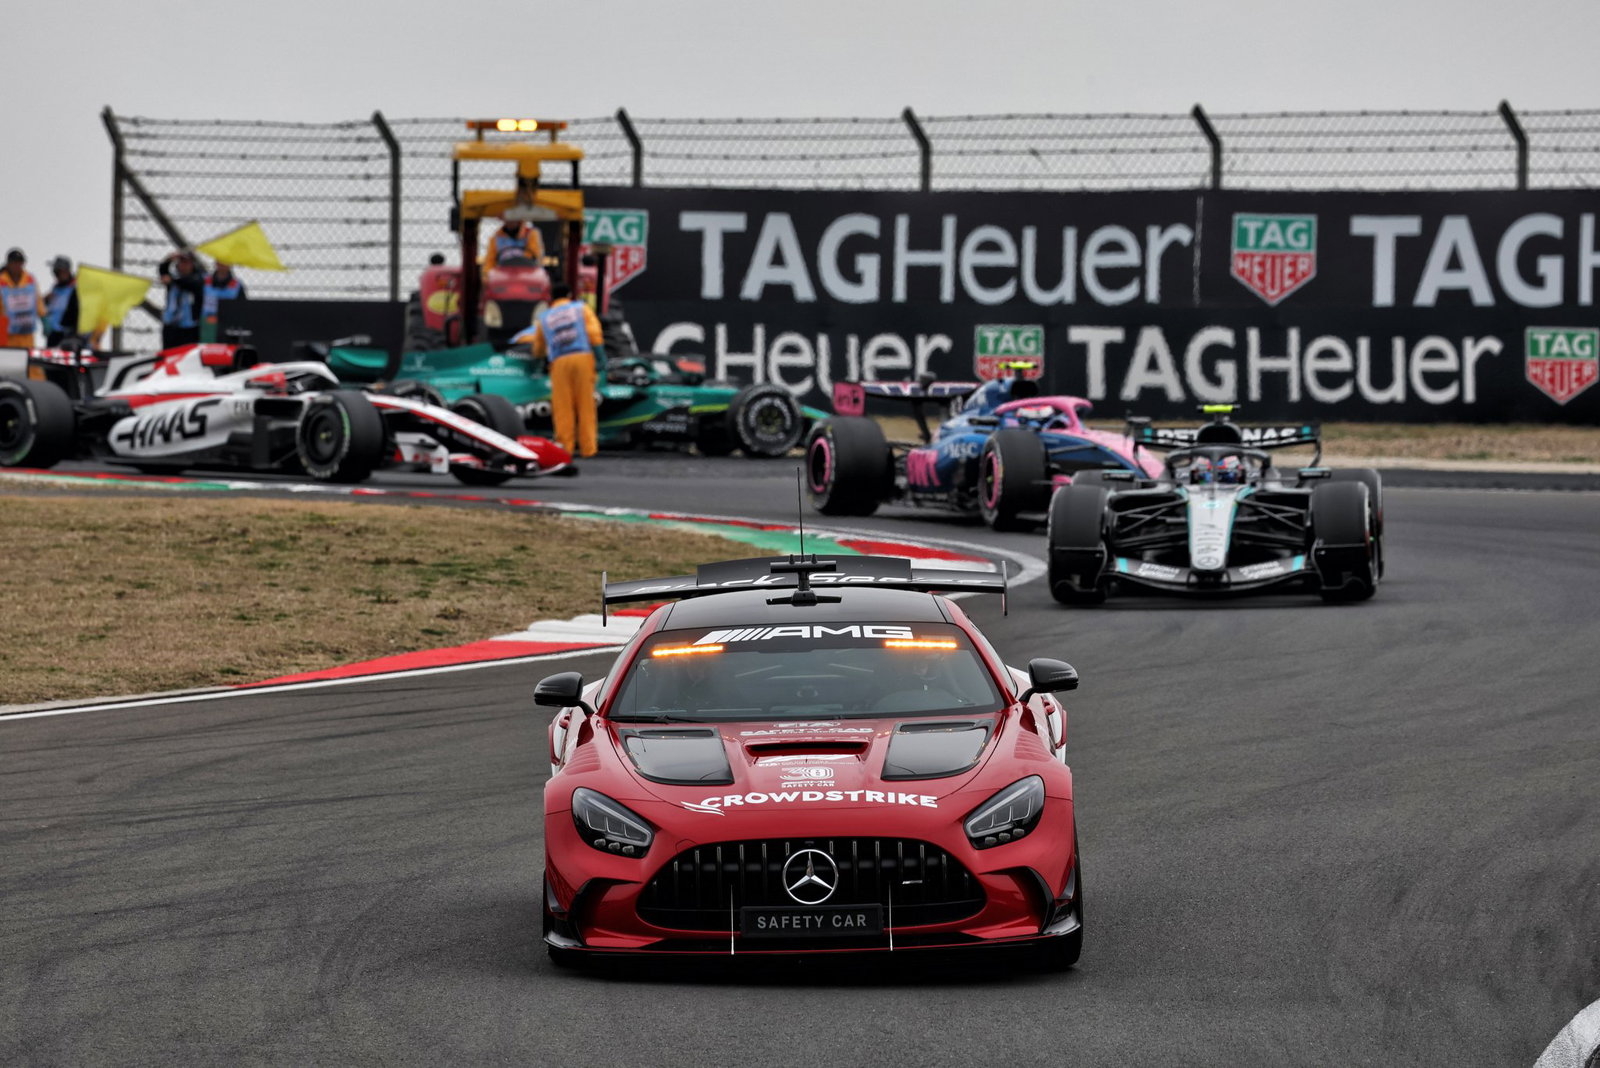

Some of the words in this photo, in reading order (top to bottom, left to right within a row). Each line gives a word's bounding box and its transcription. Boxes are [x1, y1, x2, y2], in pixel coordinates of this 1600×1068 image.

[1241, 219, 1309, 248] TAG
[1233, 254, 1312, 295] HEUER
[984, 331, 1037, 352] TAG
[1532, 333, 1592, 355] TAG
[622, 322, 954, 399] Heuer
[1528, 358, 1595, 395] HEUER
[117, 399, 222, 449] HAAS
[1157, 428, 1297, 447] PETNAS
[762, 626, 913, 640] AMG
[700, 790, 938, 809] CROWDSTRIKE
[758, 915, 825, 929] SAFETY
[833, 914, 867, 928] CAR
